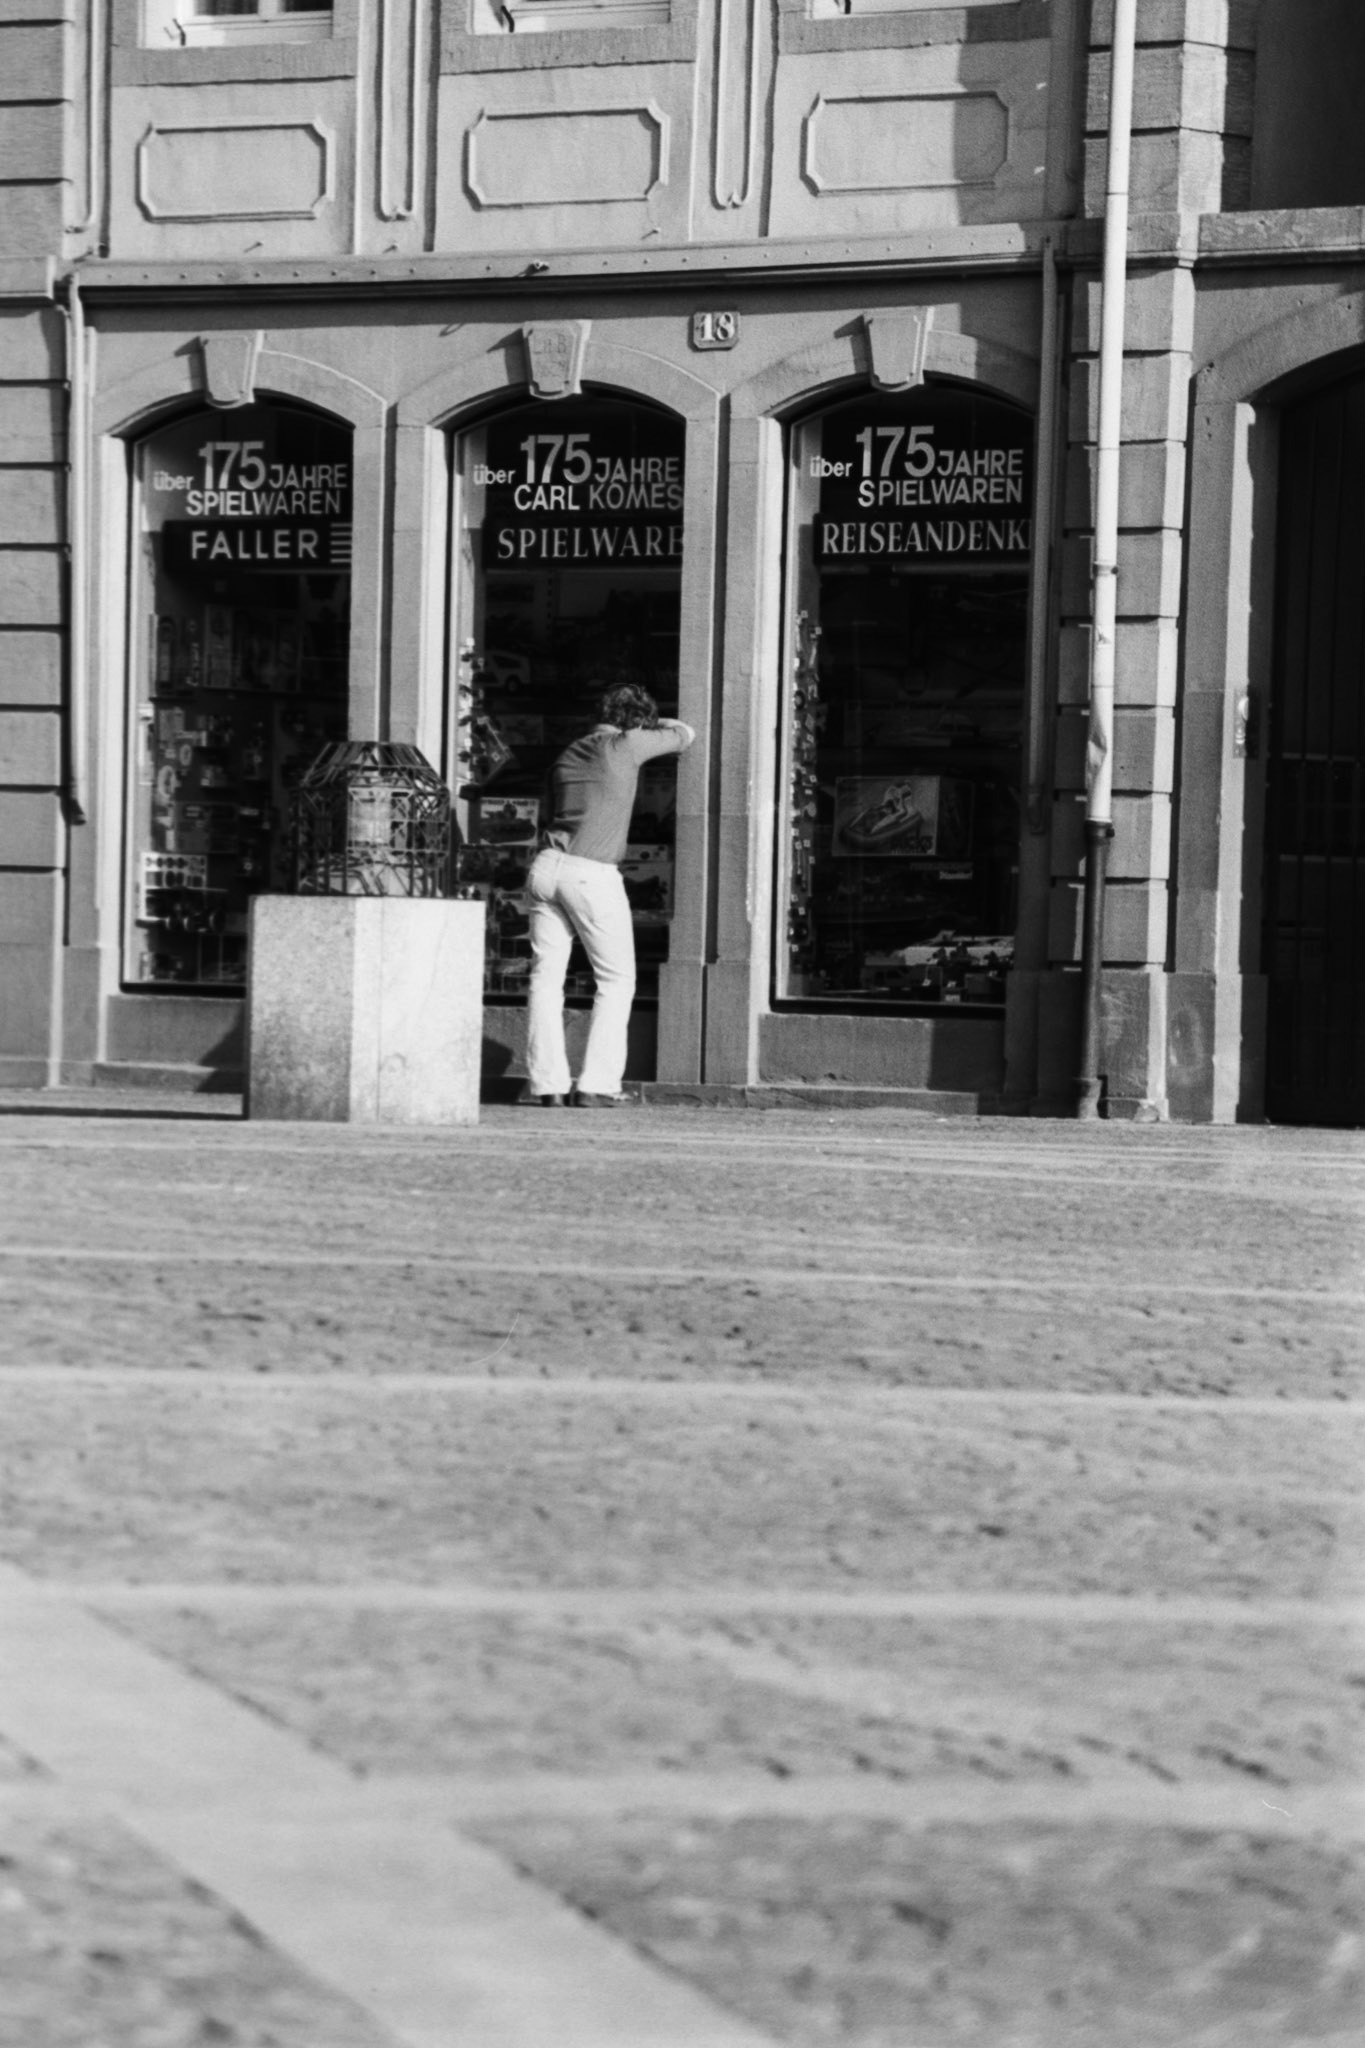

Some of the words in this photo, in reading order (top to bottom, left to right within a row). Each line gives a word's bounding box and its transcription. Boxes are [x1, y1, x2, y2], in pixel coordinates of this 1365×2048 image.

[700, 313, 735, 341] 18
[153, 470, 194, 491] über
[198, 441, 266, 490] 175
[268, 464, 348, 489] JAHRE
[473, 464, 516, 485] über
[520, 433, 592, 484] 175
[594, 457, 679, 483] JAHRE
[810, 455, 853, 477] über
[856, 425, 936, 477] 175
[936, 449, 1024, 476] JAHRE
[185, 490, 341, 516] SPIELWAREN
[514, 484, 580, 510] CARL
[589, 482, 683, 510] KOMES
[858, 477, 1023, 507] SPIELWAREN
[191, 529, 319, 559] FALLER
[822, 519, 1033, 554] REISEANDENK
